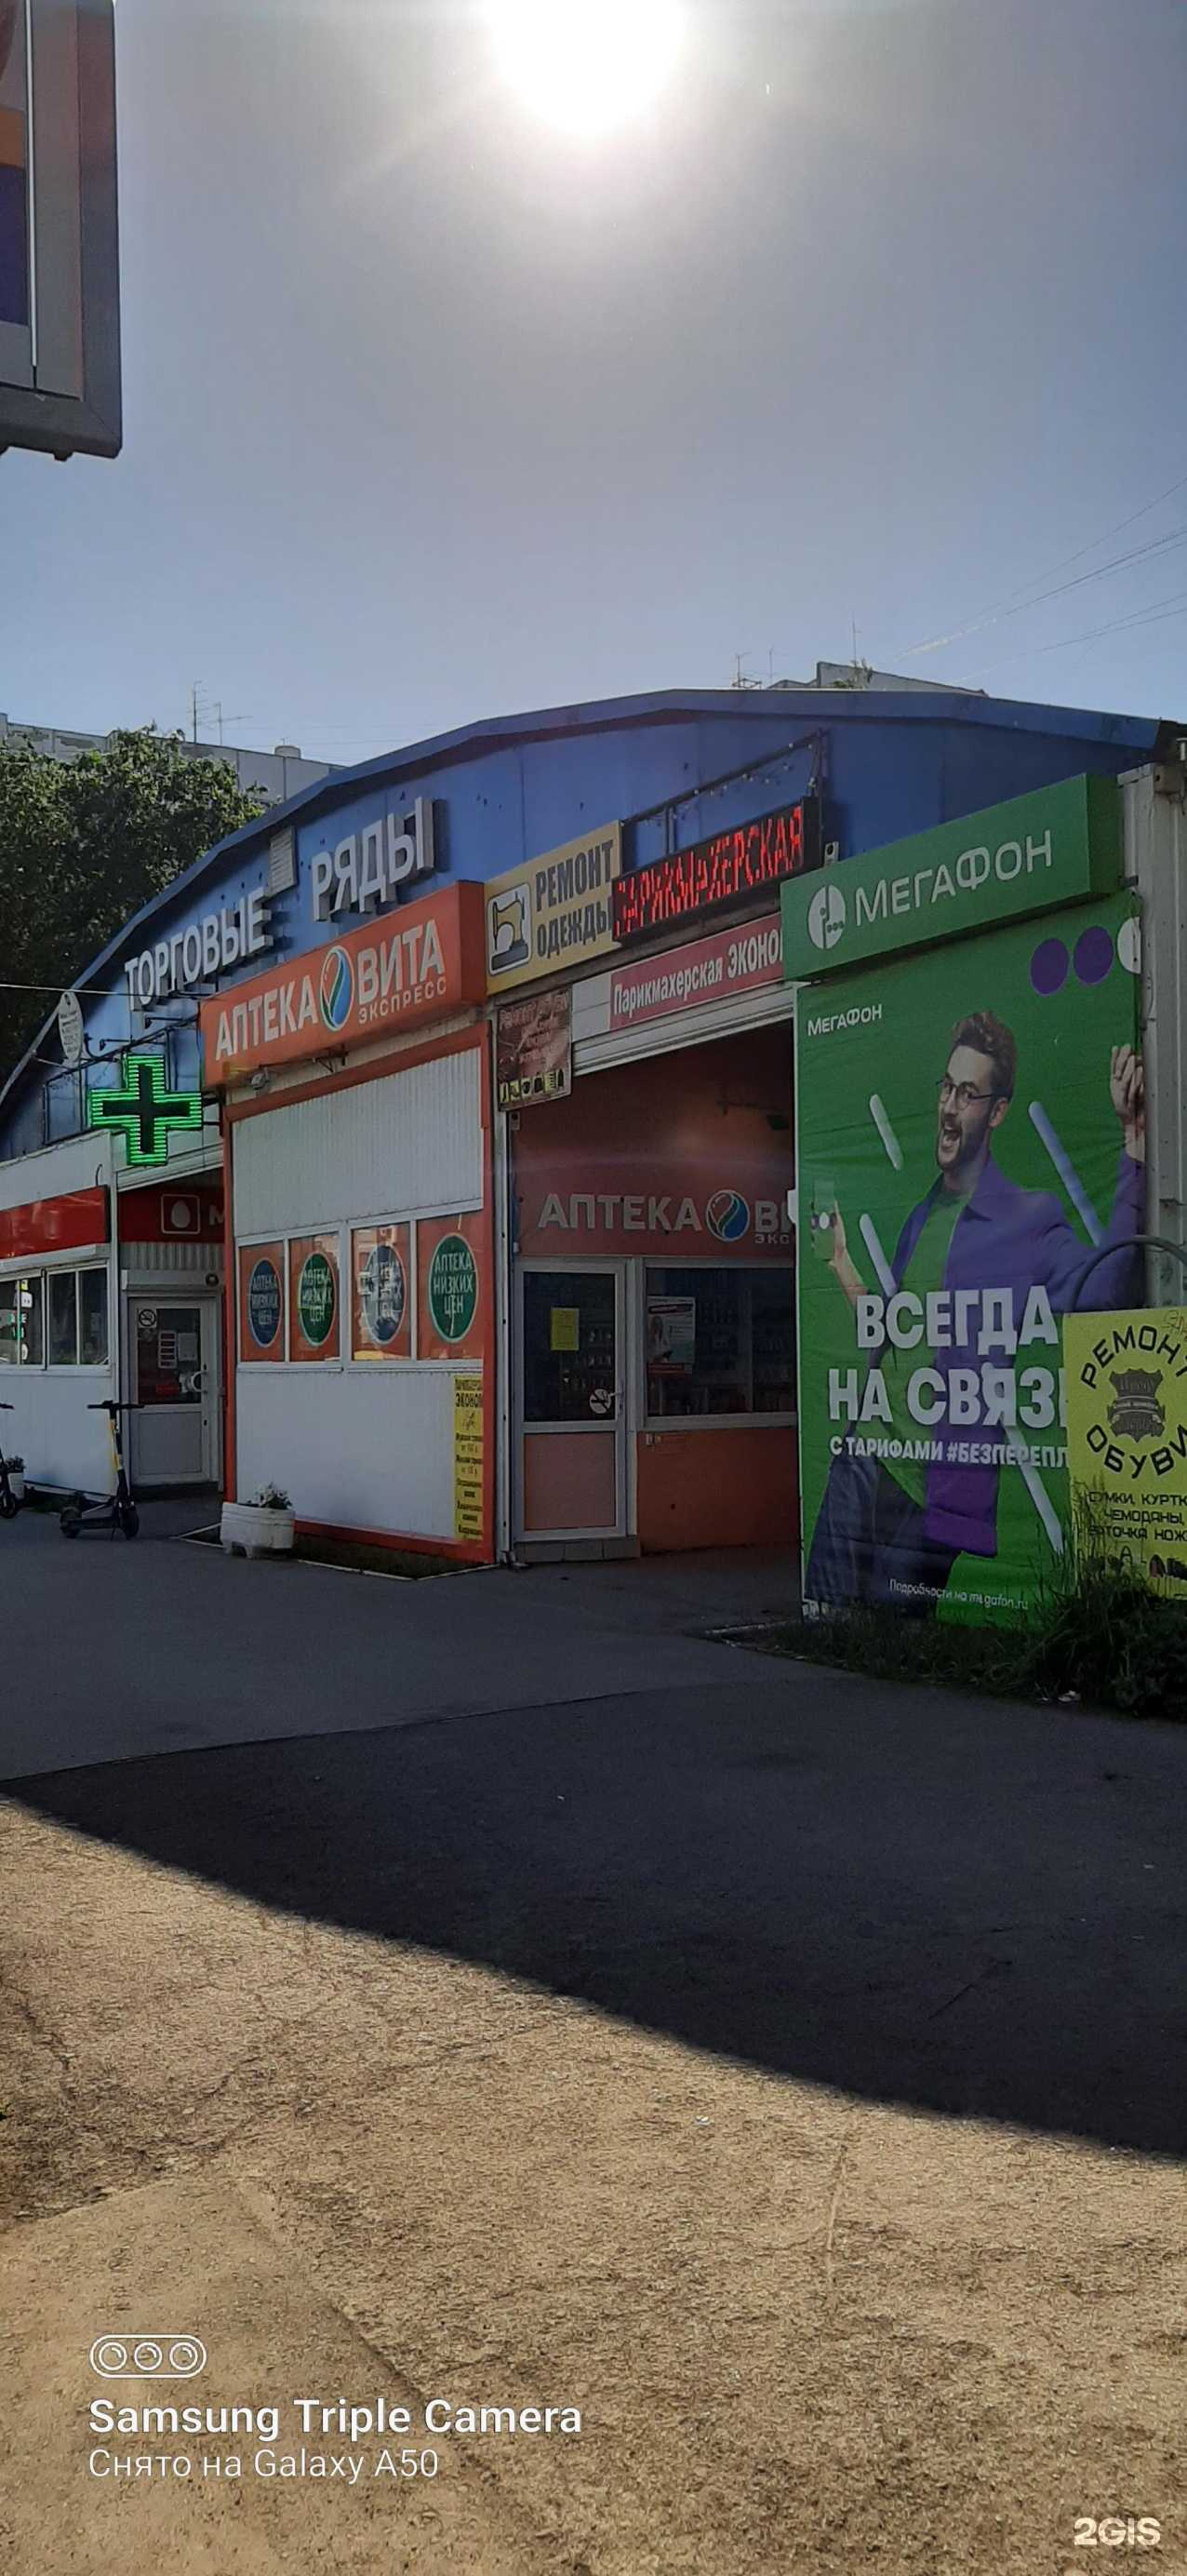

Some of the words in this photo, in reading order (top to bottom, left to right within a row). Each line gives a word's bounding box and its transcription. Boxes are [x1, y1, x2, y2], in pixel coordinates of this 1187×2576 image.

[535, 839, 614, 912] РЕМОНТ
[125, 887, 273, 1012] ТОРГОВЫЕ
[311, 797, 434, 921] РЯДЫ
[537, 896, 613, 959] ОДЕЖДЫ
[215, 974, 318, 1061] АПТЕКА
[357, 919, 446, 1005] ВИТА
[358, 976, 447, 1025] ЭКСПРЕСС
[613, 957, 723, 1019] Парикмахерская
[727, 929, 783, 979] ЭКОНО
[538, 1193, 702, 1232] АПТЕКА
[754, 1201, 790, 1234] В
[433, 1272, 473, 1295] НИЗКИХ
[434, 1250, 473, 1274] АПТЕКА
[444, 1295, 464, 1318] ЦЕН
[857, 1285, 1059, 1355] ВСЕГДА
[828, 1368, 893, 1423] НА
[830, 1435, 843, 1456] С
[846, 1436, 943, 1461] ТАРИФАМИ
